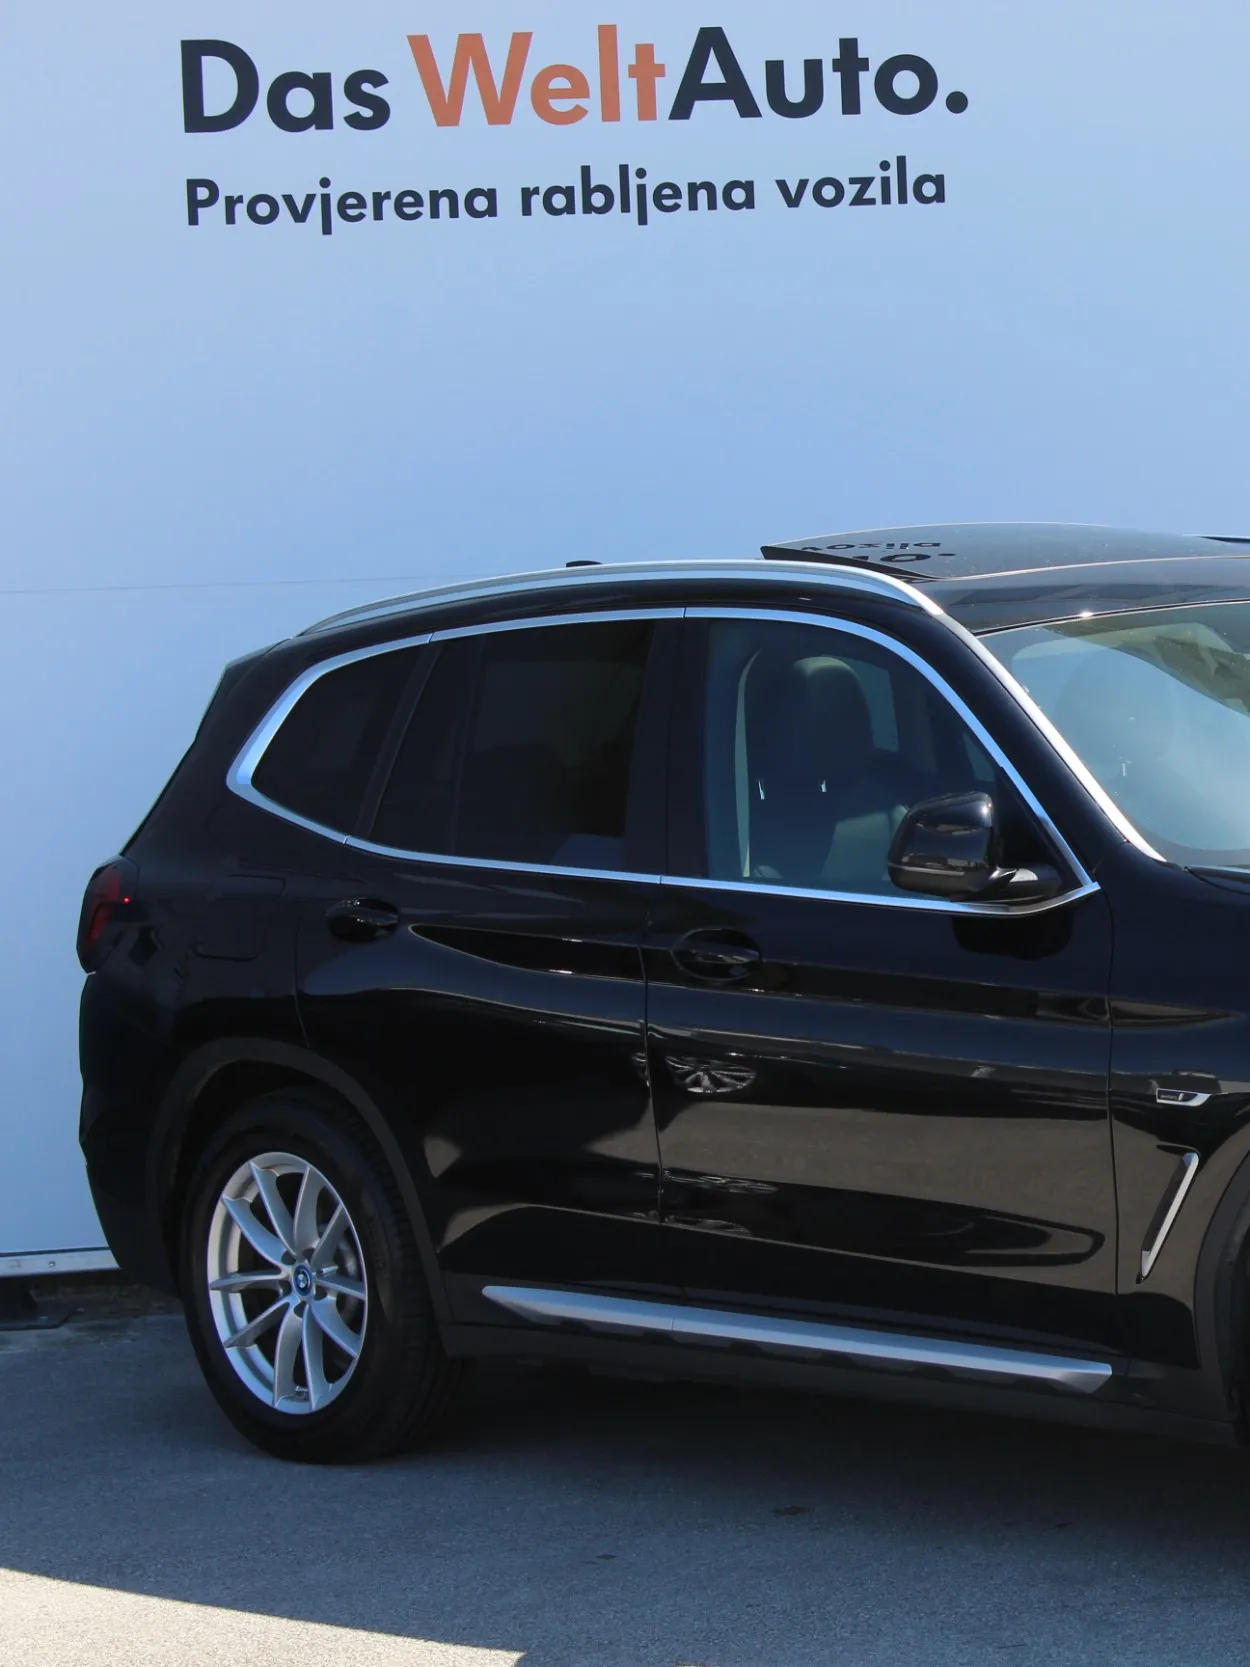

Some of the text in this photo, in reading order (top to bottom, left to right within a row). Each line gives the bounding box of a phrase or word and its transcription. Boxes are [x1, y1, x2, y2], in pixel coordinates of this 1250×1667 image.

[181, 25, 968, 133] Das WeltAuto.
[187, 155, 945, 235] Provjerena rabljena vozila
